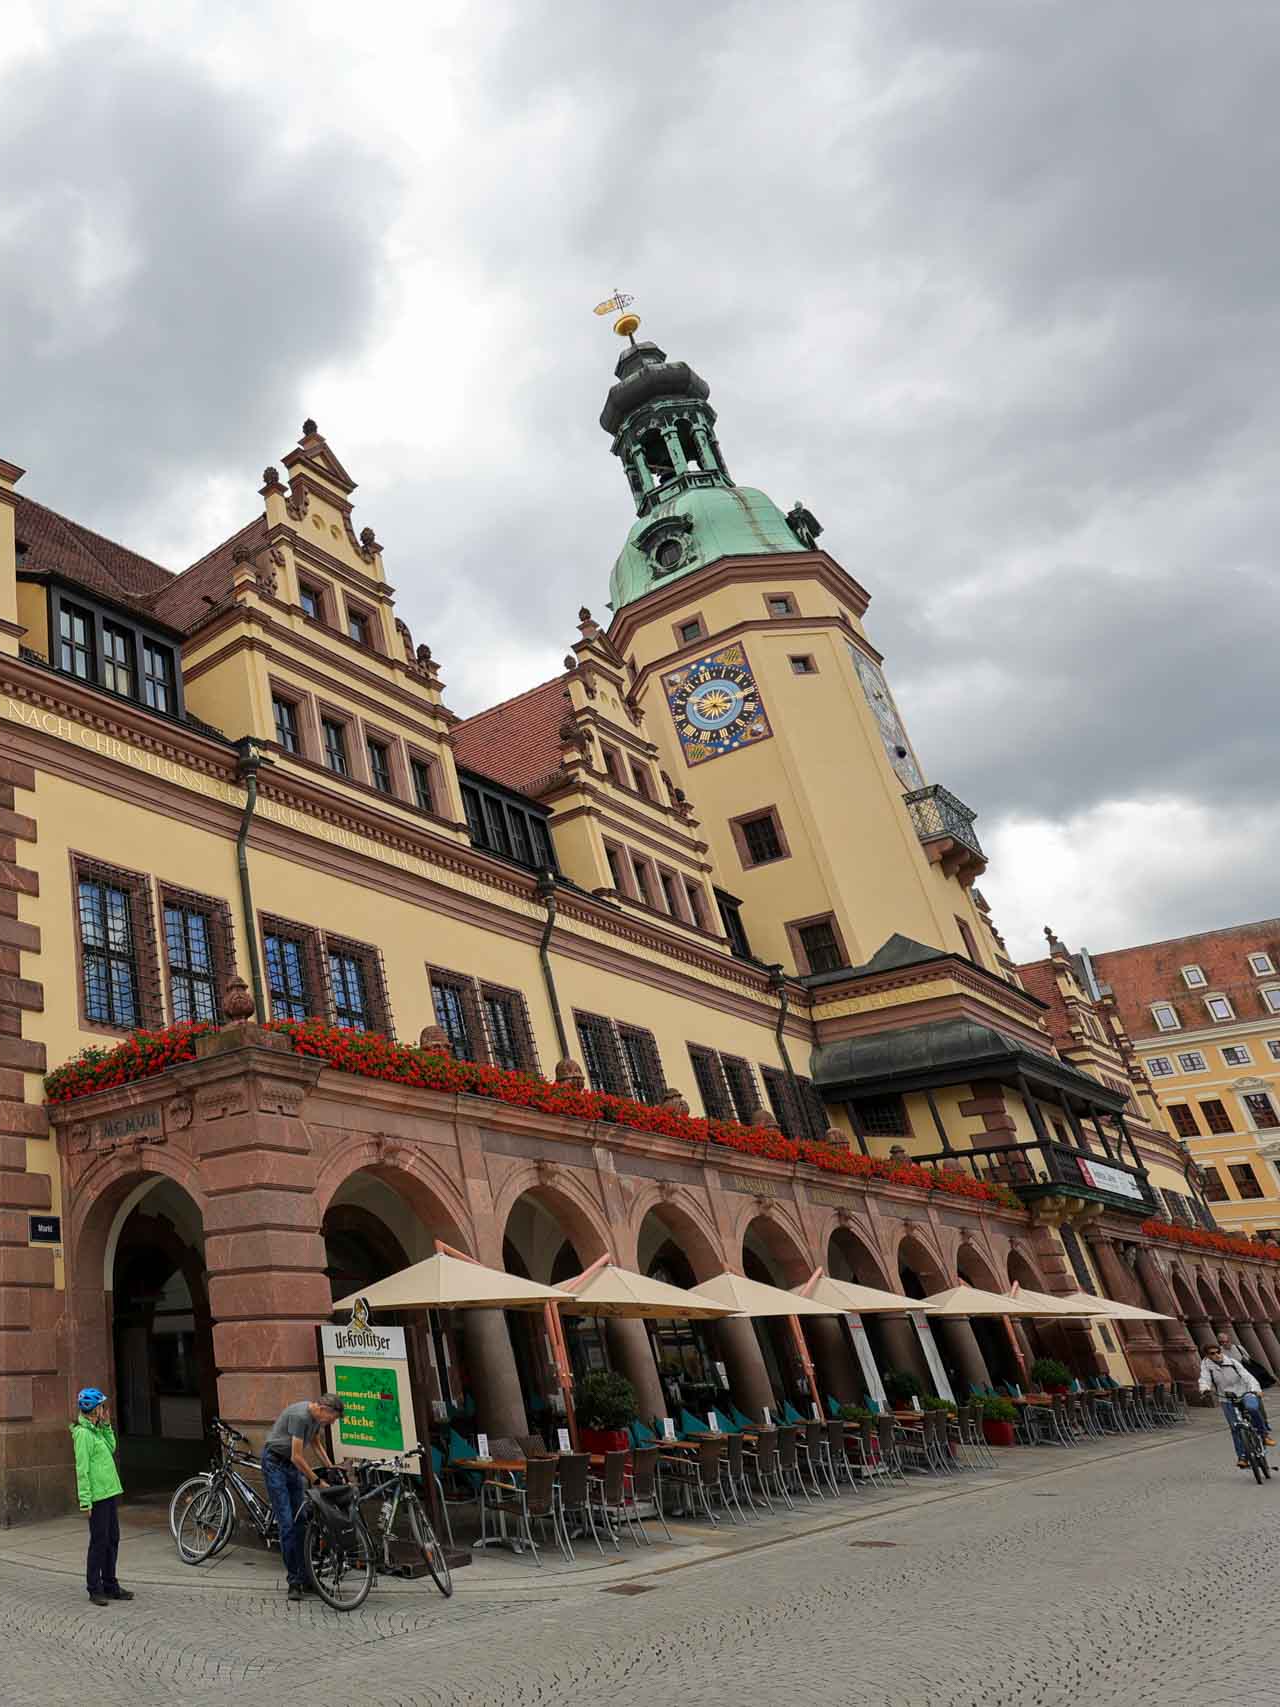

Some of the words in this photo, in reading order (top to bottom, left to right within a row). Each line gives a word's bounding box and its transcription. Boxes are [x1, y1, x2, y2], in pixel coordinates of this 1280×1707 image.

[8, 700, 73, 741] NACH
[80, 728, 163, 774] CHRISTI
[343, 1415, 376, 1428] Küche
